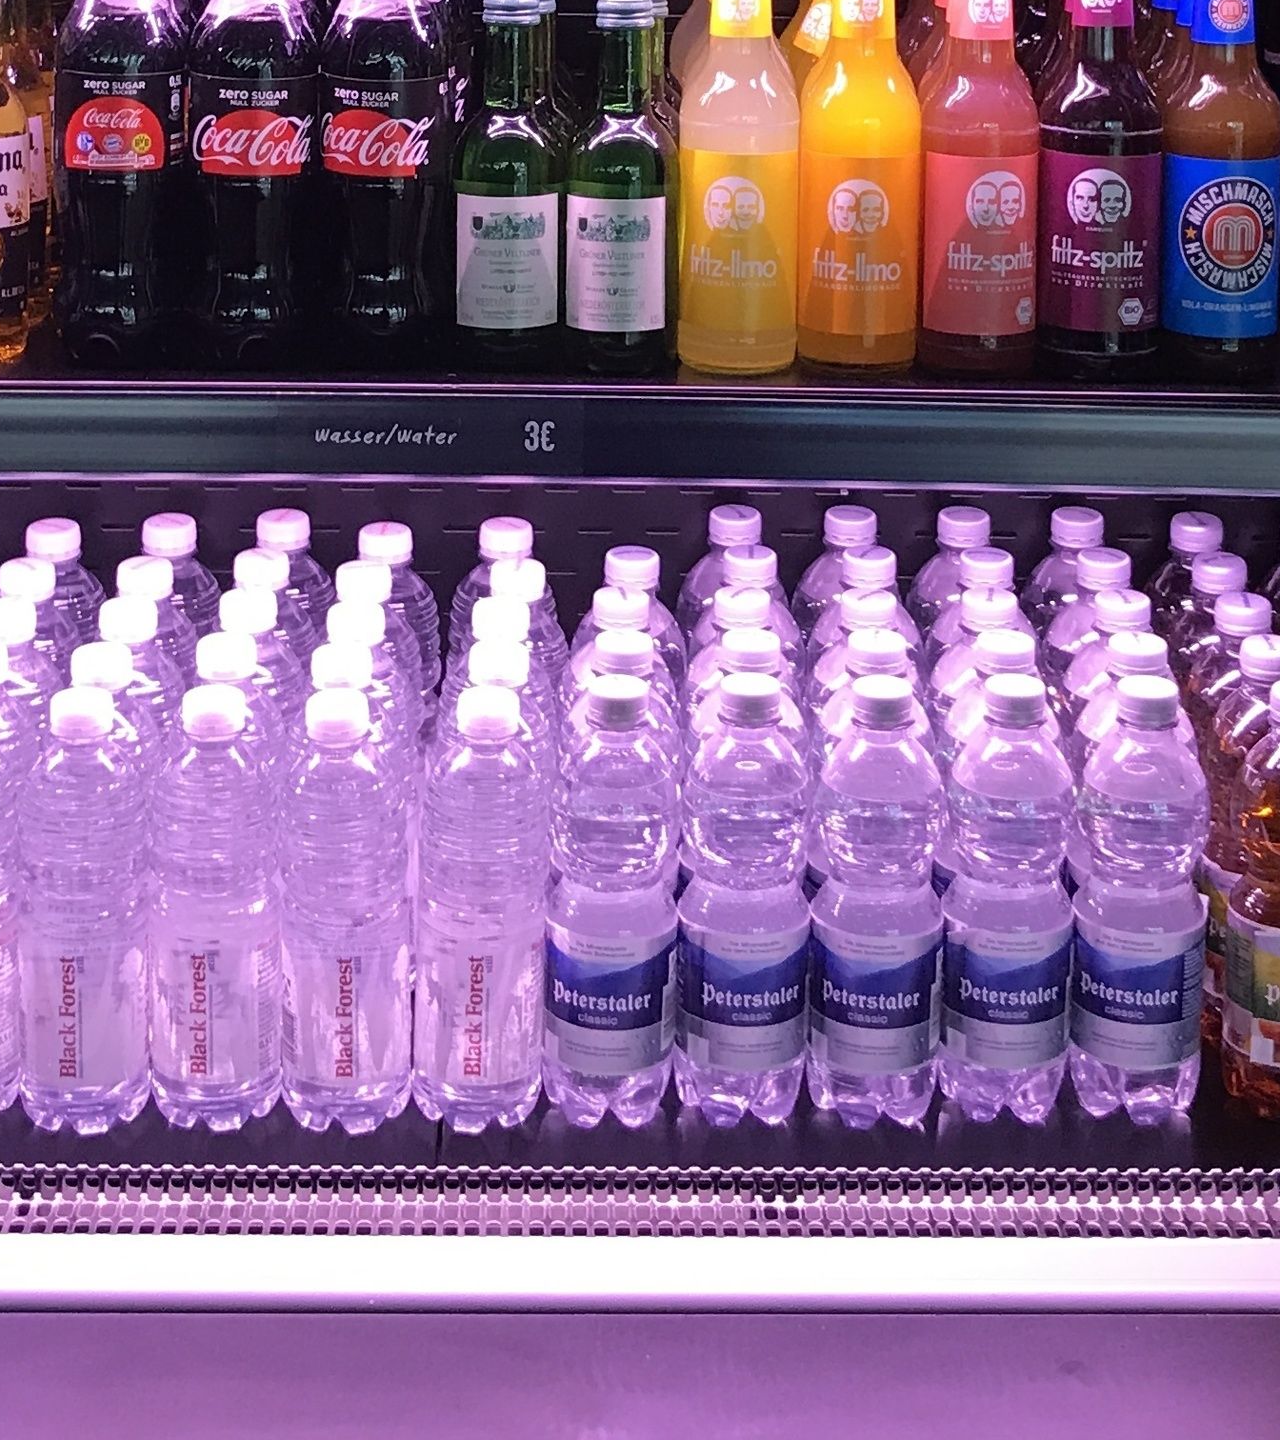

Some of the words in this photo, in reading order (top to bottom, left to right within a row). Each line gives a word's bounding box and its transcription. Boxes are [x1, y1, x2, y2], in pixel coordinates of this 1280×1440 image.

[83, 79, 110, 91] zero
[112, 80, 146, 90] SUGAR
[219, 88, 249, 100] zero
[251, 90, 288, 101] SUGAR
[334, 87, 359, 100] zero
[361, 91, 399, 102] SUGAR
[83, 108, 143, 130] Coca-Cola
[192, 114, 315, 167] Coca-Cola
[1185, 182, 1274, 226] MISCHMASCH
[1050, 235, 1145, 274] fritz-spritz
[1184, 241, 1273, 289] MISCHMASCH
[524, 420, 555, 452] 3€
[58, 955, 77, 1016] Forest
[189, 953, 208, 1013] Forest
[334, 956, 354, 1018] Forest
[463, 955, 486, 1016] Forest
[553, 979, 652, 1012] Peterstaler
[702, 981, 799, 1009] Peterstaler
[822, 978, 920, 1011] Peterstaler
[958, 977, 1059, 1007] Peterstaler
[1081, 971, 1178, 1006] Peterstaler
[578, 1013, 618, 1026] classic
[847, 1012, 888, 1025] classic
[58, 1019, 77, 1079] Black
[189, 1016, 208, 1075] Black
[334, 1022, 354, 1079] Black
[463, 1019, 483, 1077] Black
